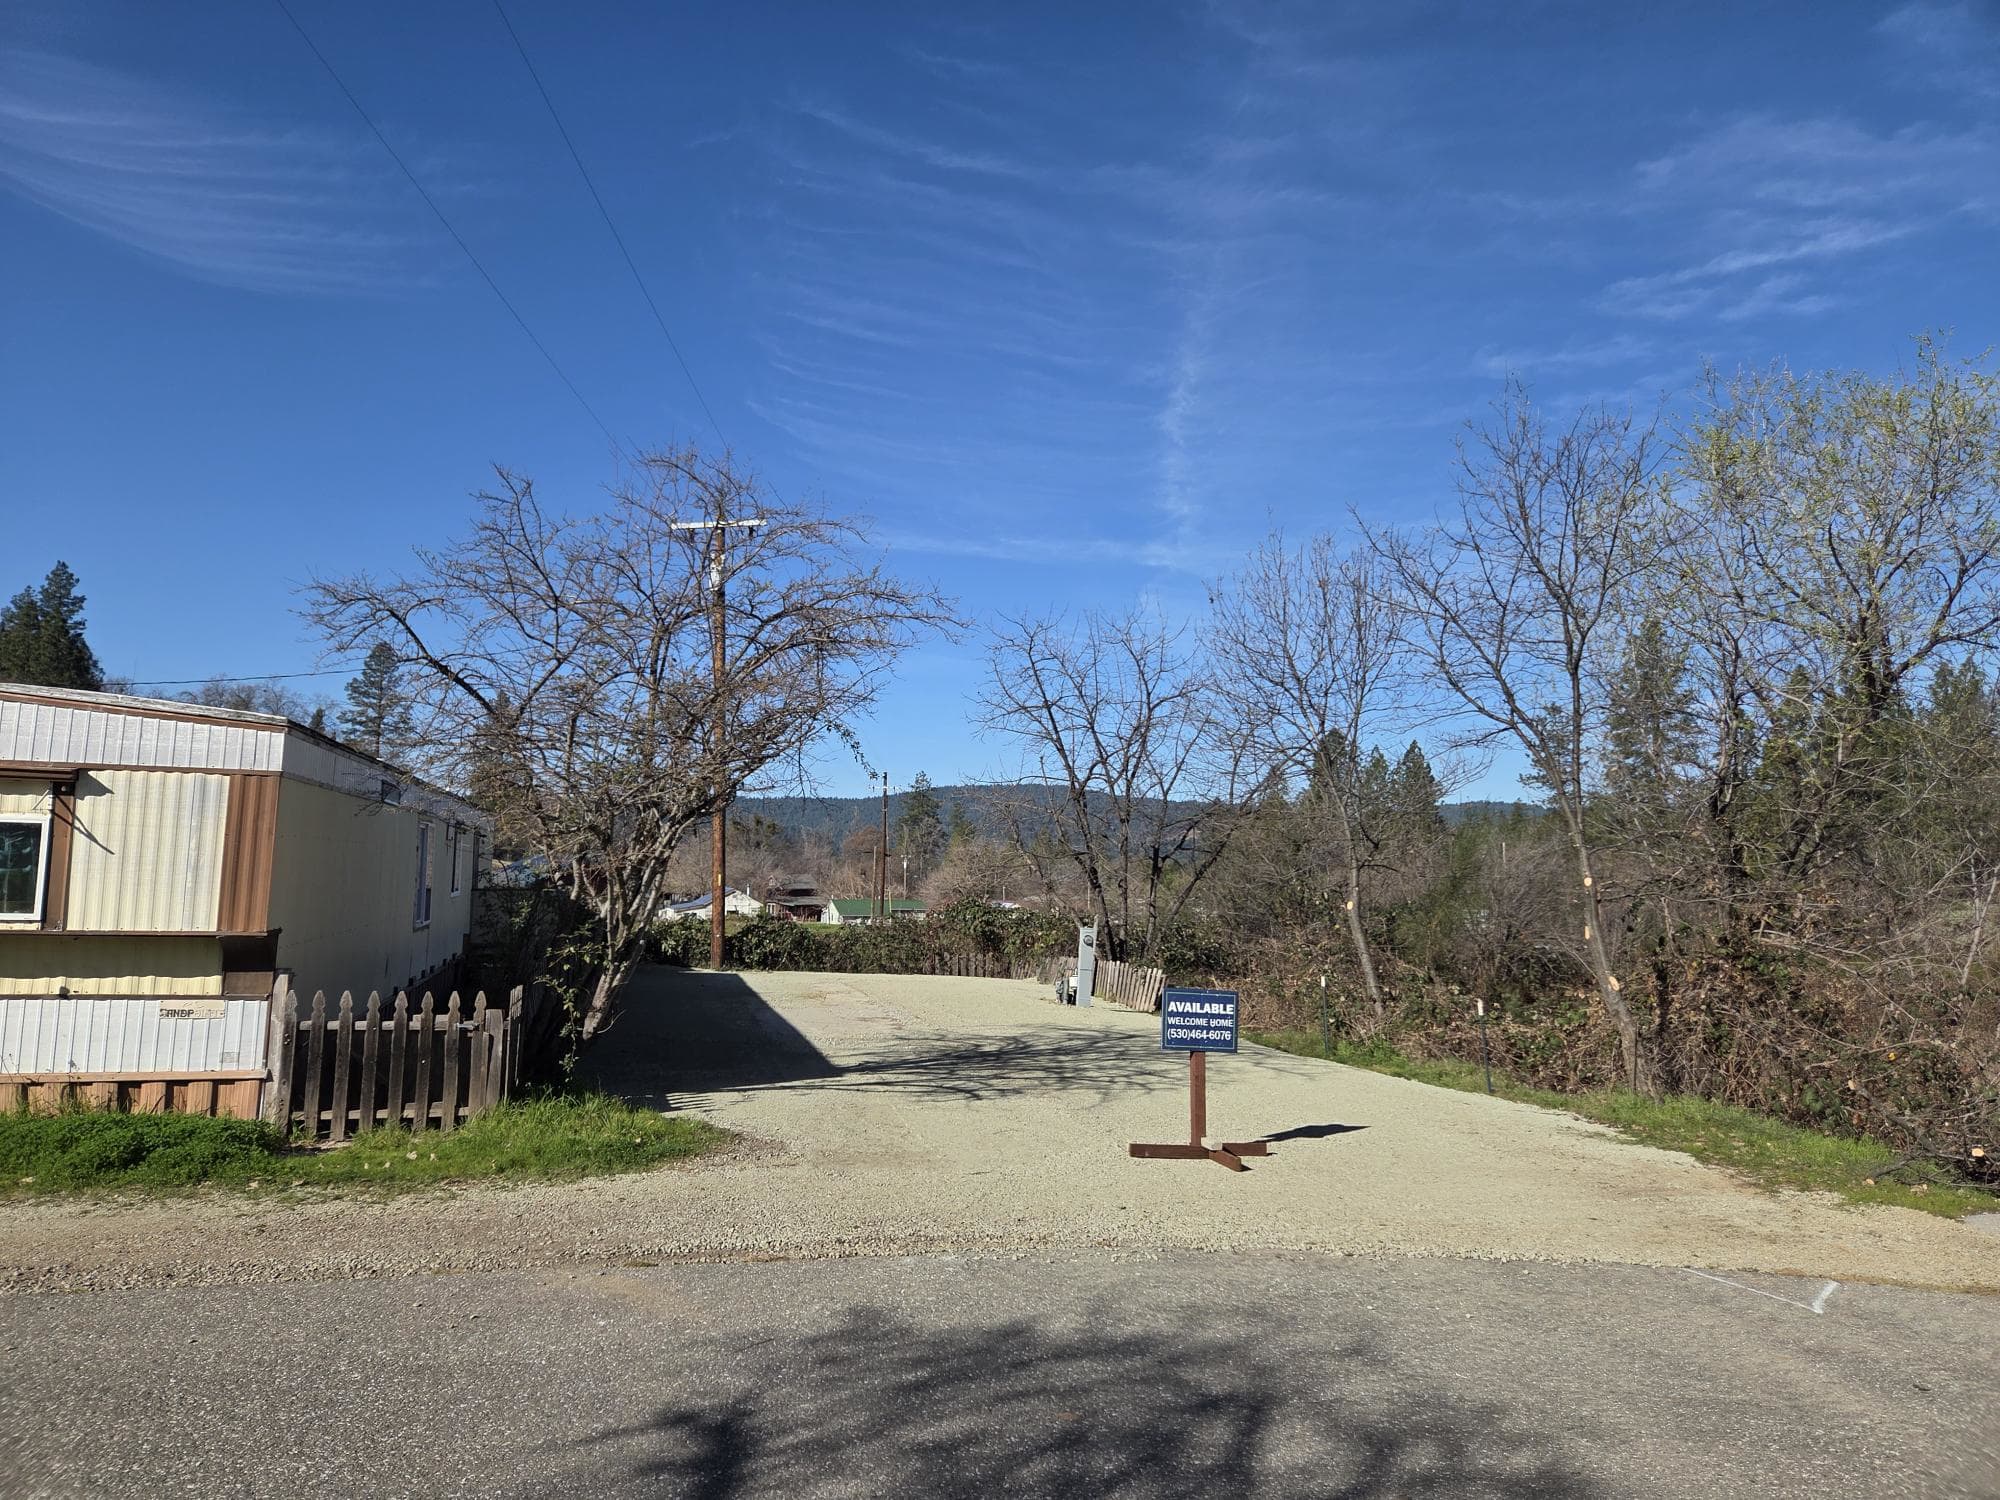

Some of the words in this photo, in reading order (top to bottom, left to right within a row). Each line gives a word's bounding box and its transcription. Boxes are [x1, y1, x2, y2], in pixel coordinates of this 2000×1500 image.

[1168, 1001, 1234, 1014] AVAILABLE
[1167, 1016, 1208, 1026] WELCOME
[1209, 1018, 1234, 1028] HOME
